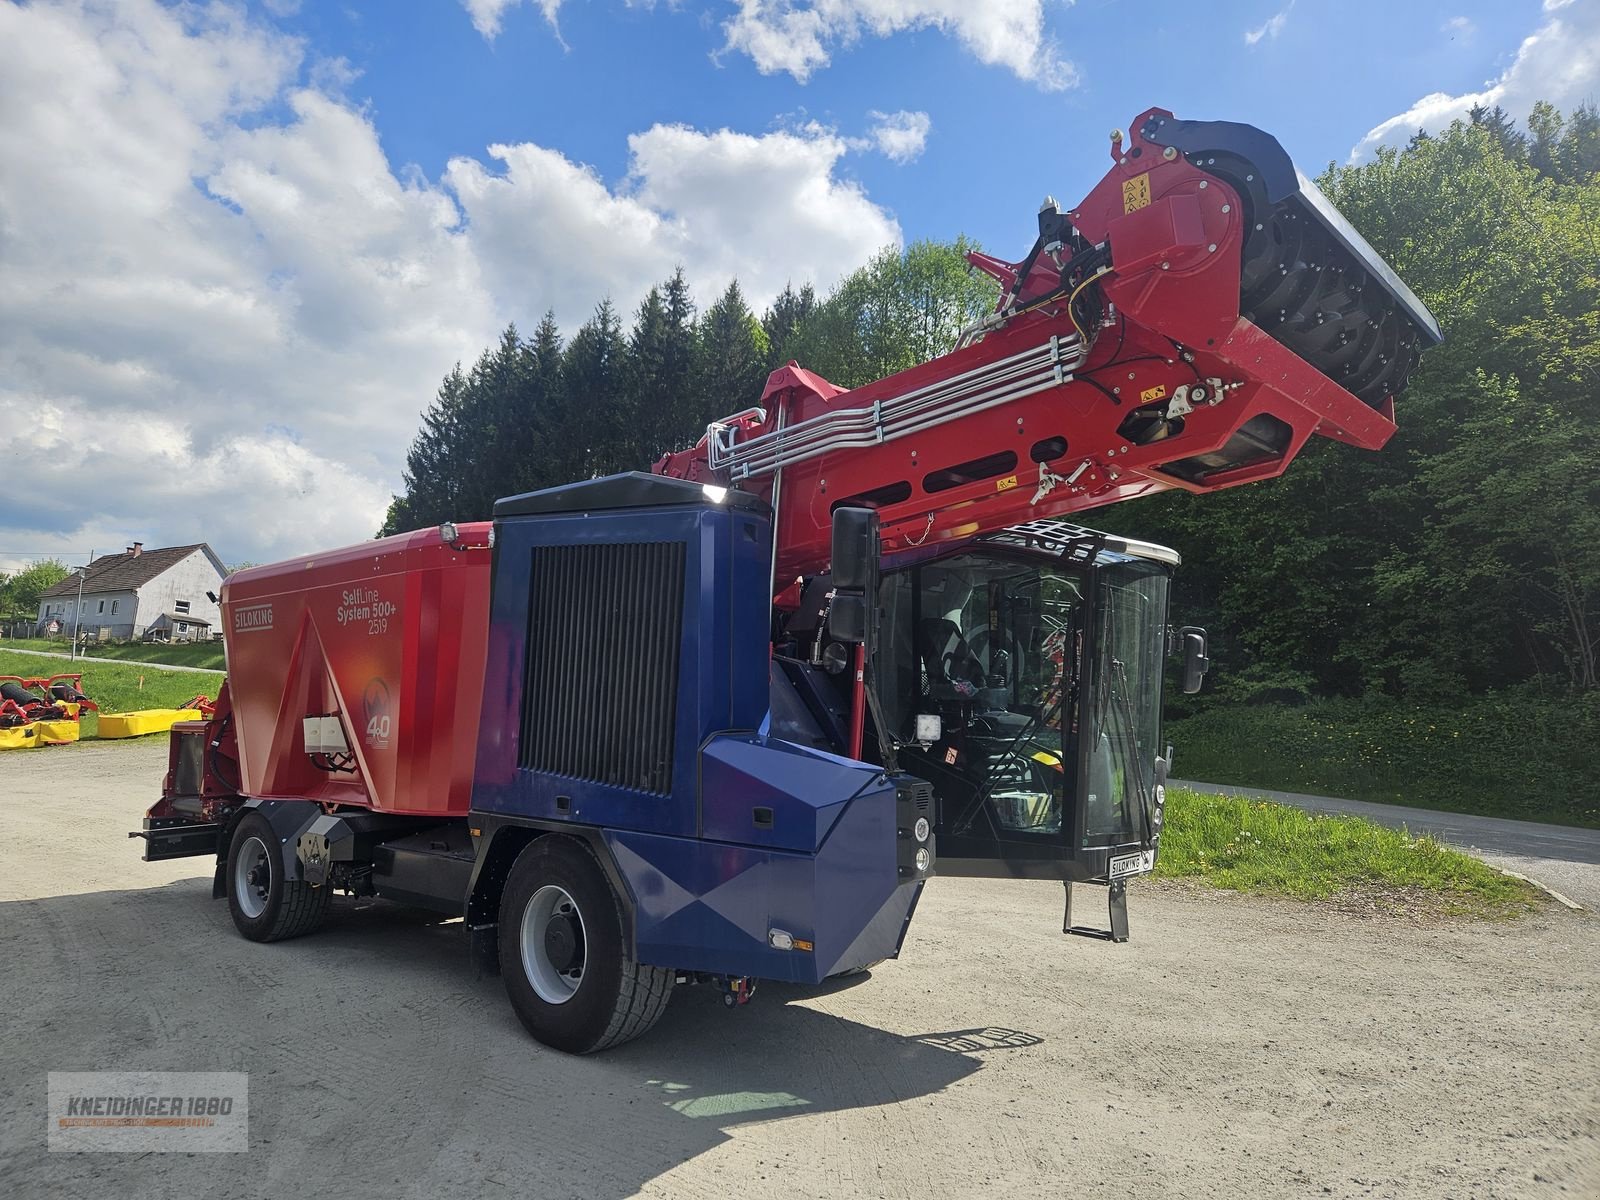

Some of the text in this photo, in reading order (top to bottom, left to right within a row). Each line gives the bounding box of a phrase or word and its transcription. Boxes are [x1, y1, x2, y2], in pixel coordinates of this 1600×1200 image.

[342, 586, 379, 606] SelfLine
[235, 608, 273, 628] SILOKING
[337, 601, 396, 626] System 500+
[368, 618, 388, 635] 2519
[1112, 857, 1140, 873] SILOKING
